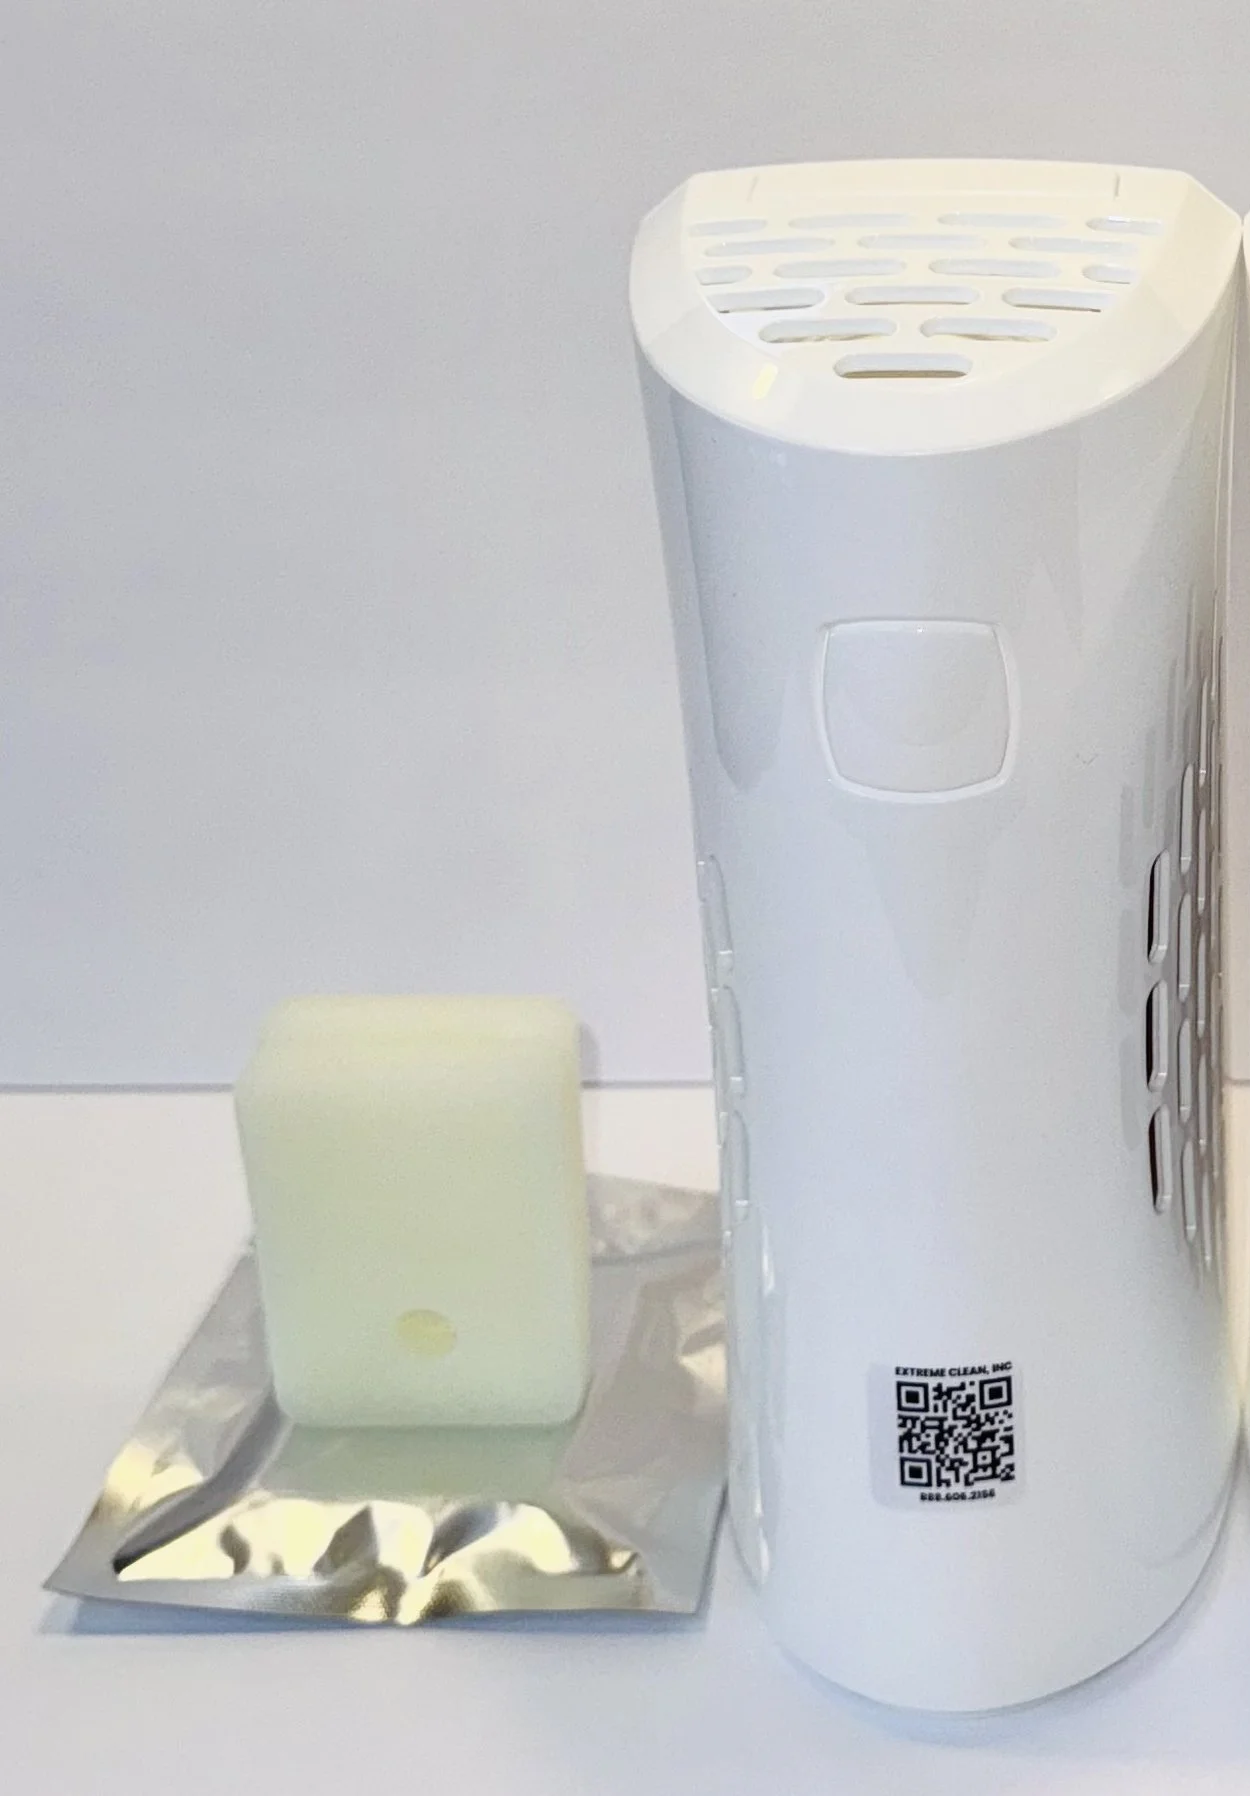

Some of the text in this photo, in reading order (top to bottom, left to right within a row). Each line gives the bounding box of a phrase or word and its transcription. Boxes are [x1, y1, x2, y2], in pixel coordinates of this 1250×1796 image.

[895, 1361, 1012, 1377] EXTREME CLEAN, INC
